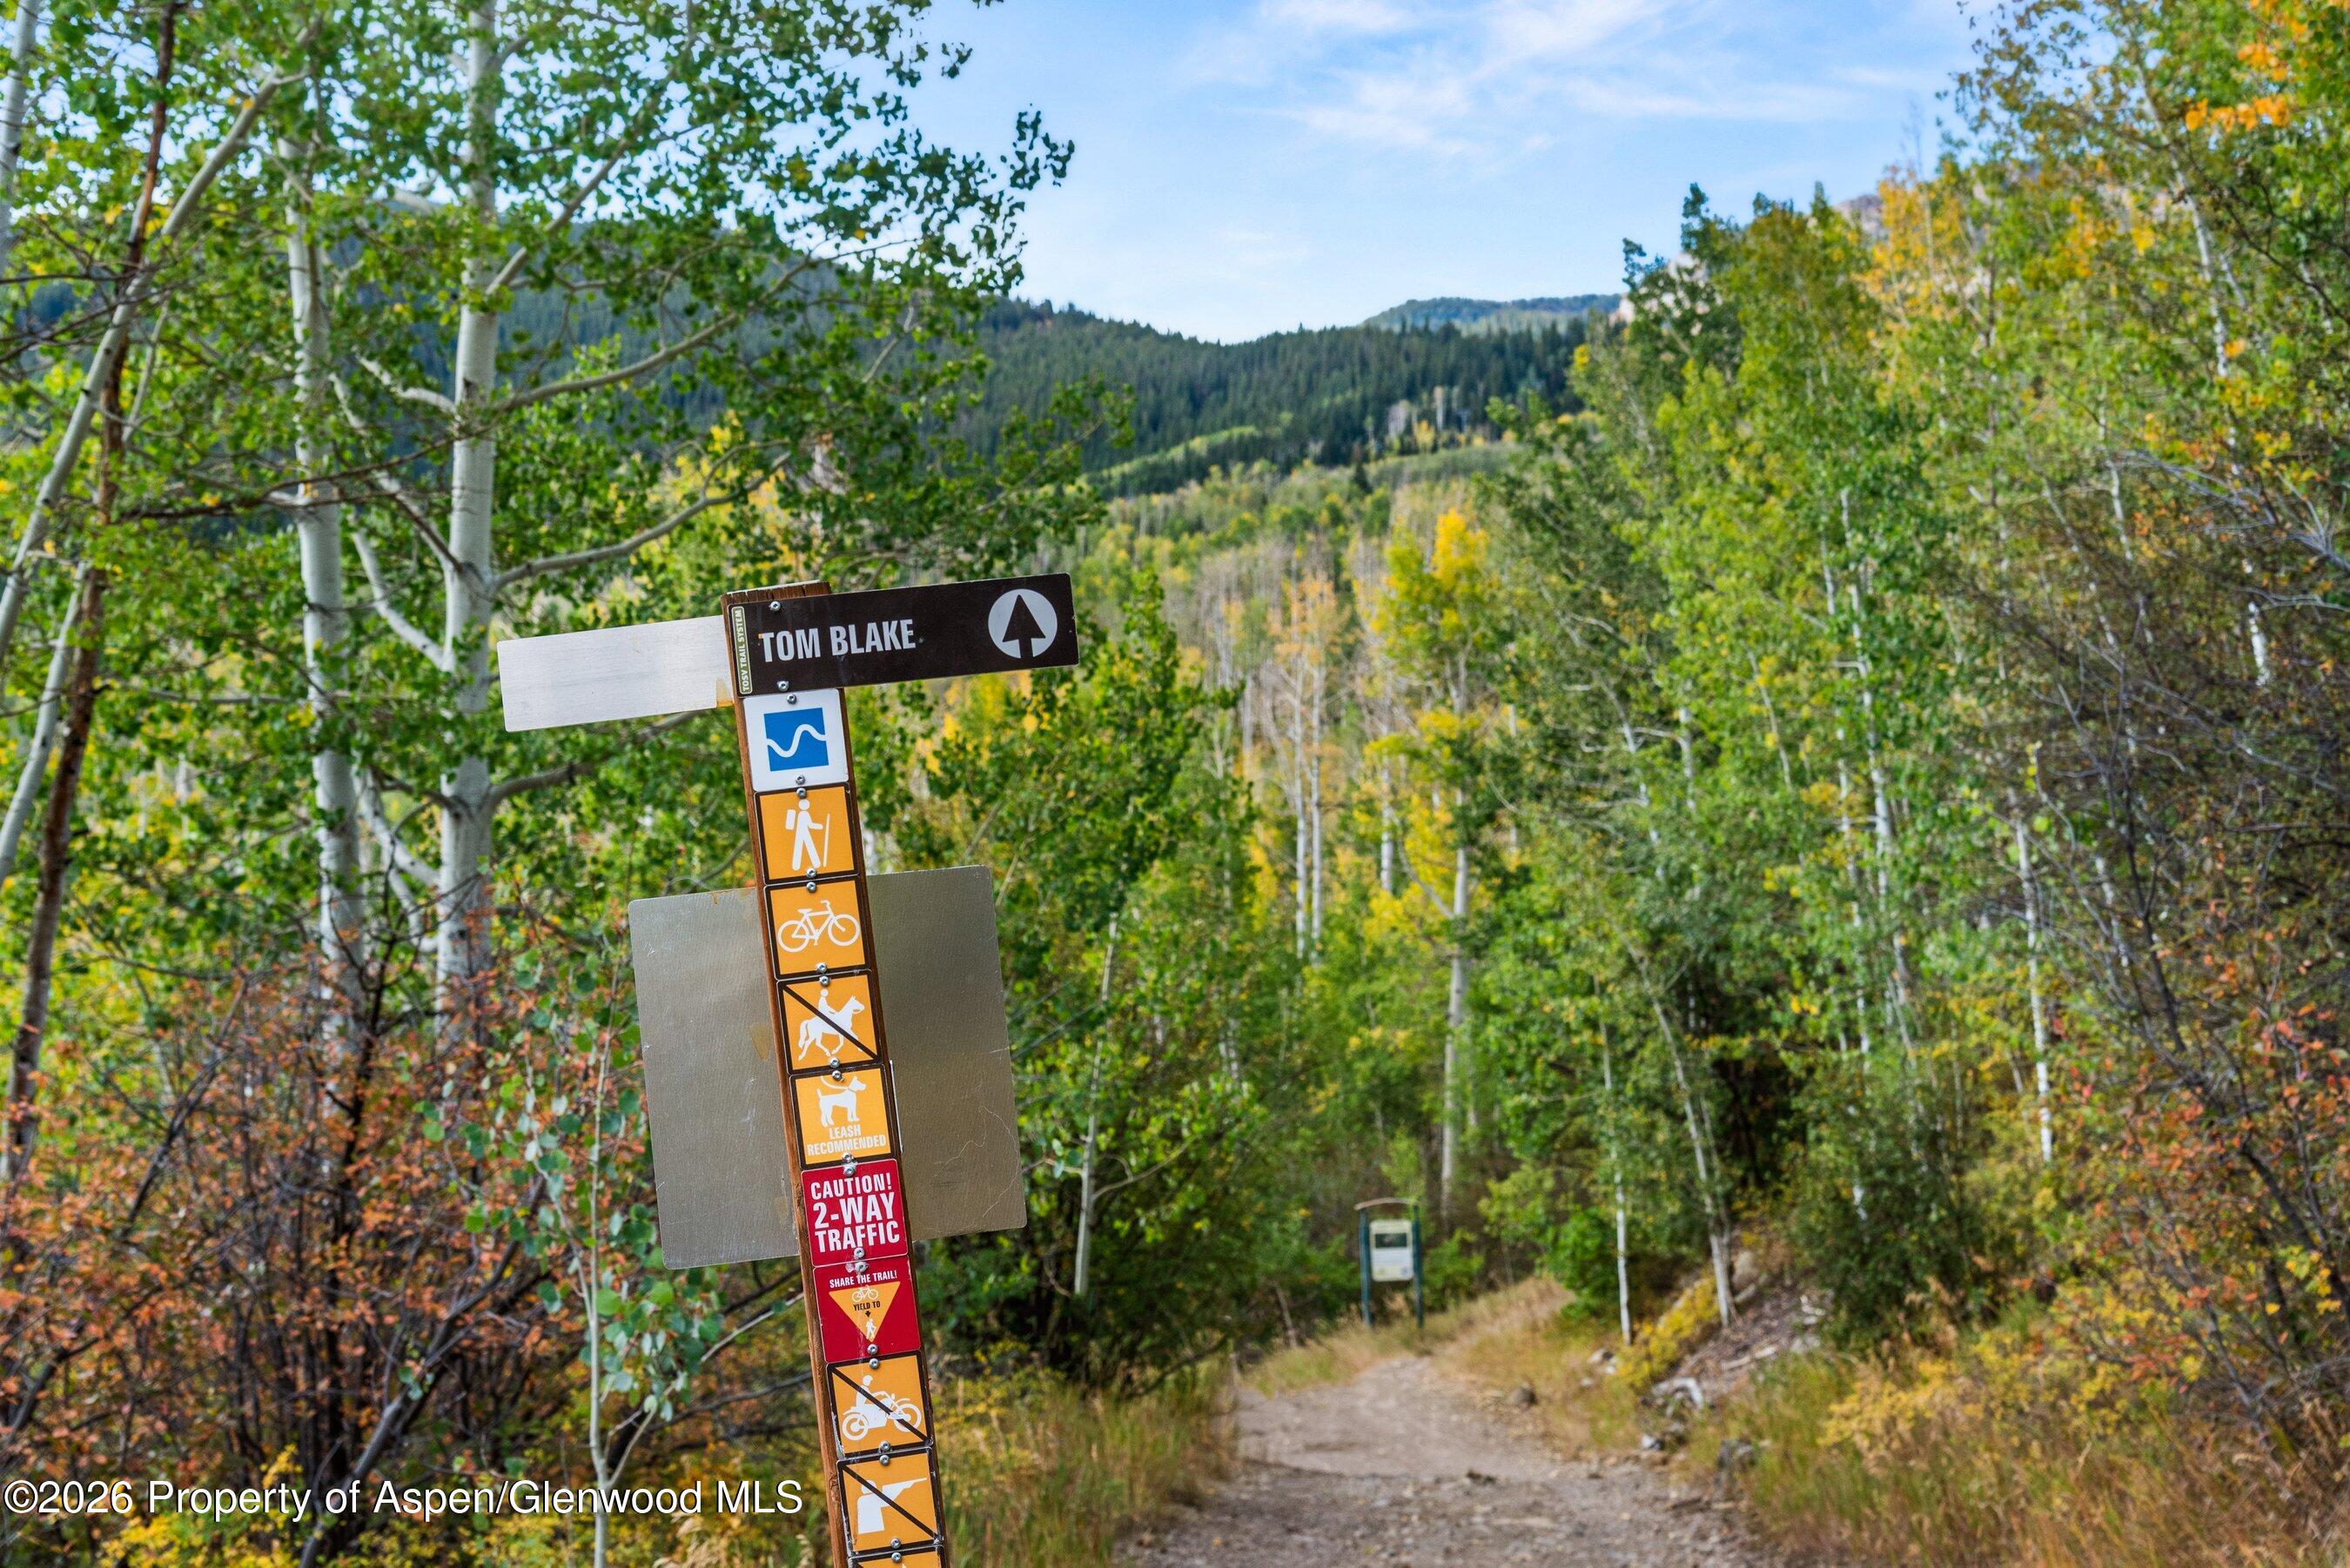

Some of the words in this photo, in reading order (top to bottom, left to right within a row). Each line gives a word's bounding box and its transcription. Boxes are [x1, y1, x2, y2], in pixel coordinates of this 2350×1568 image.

[735, 609, 745, 642] SYSTEM
[759, 627, 822, 663] TOM
[829, 619, 916, 657] BLAKE
[738, 643, 747, 668] TRAIL
[741, 669, 749, 693] TOSV
[829, 1124, 862, 1140] LEASH
[807, 1135, 887, 1156] RECOMMENDED
[810, 1172, 892, 1200] CAUTION!
[813, 1191, 895, 1230] 2-WAY
[815, 1220, 900, 1253] TRAFFIC
[829, 1276, 855, 1288] SHARE
[856, 1274, 871, 1283] THE
[872, 1270, 897, 1282] TRAIL!
[853, 1302, 871, 1311] YIELD
[872, 1300, 881, 1309] TO
